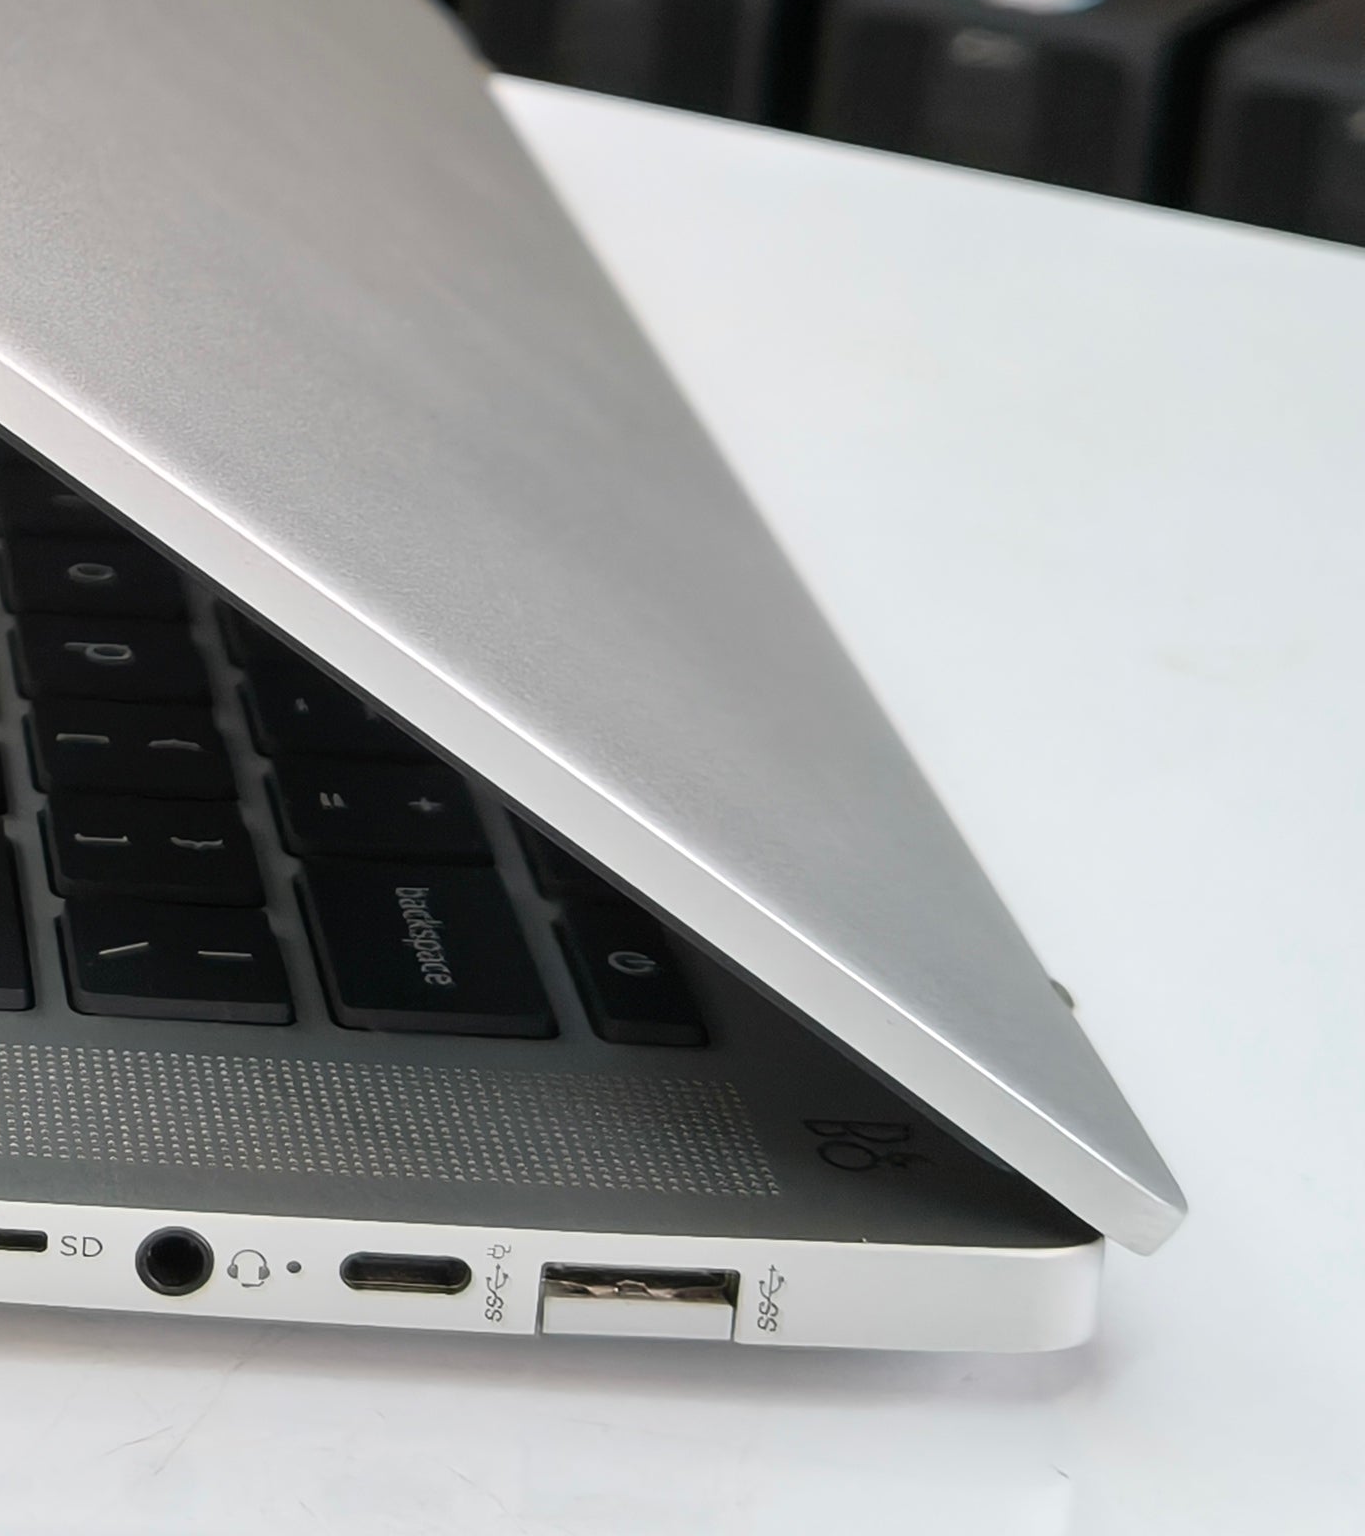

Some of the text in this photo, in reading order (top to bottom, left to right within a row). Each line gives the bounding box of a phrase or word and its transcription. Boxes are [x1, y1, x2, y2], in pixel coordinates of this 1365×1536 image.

[67, 562, 117, 583] o
[64, 641, 135, 664] p
[394, 886, 455, 987] backspace
[59, 1234, 104, 1258] SD
